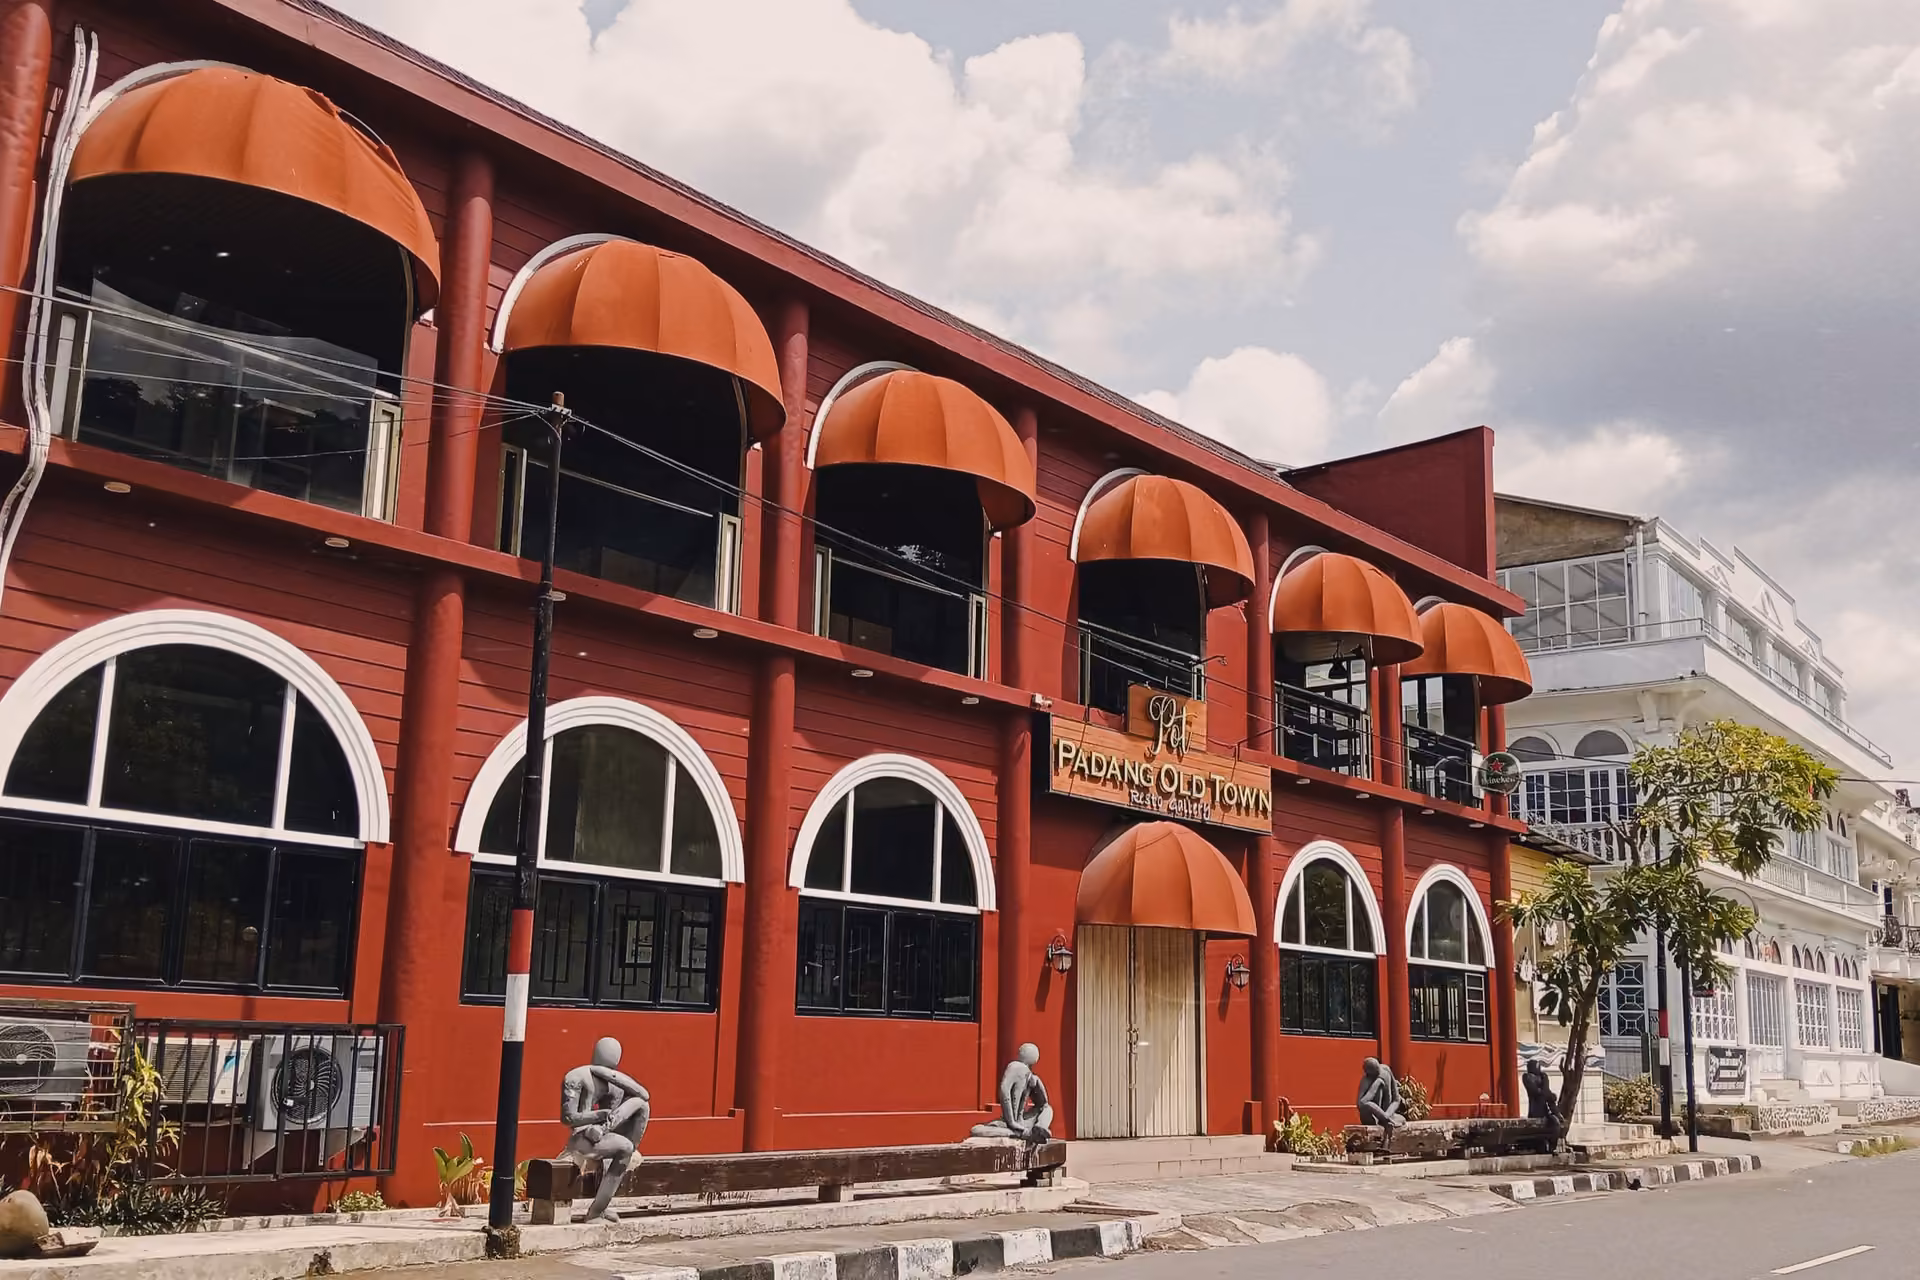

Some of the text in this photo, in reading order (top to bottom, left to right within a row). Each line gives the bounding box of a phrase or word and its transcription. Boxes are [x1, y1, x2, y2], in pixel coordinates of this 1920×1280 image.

[1057, 738, 1272, 812] PADANG OLD TOWN
[1130, 789, 1163, 808] Resto
